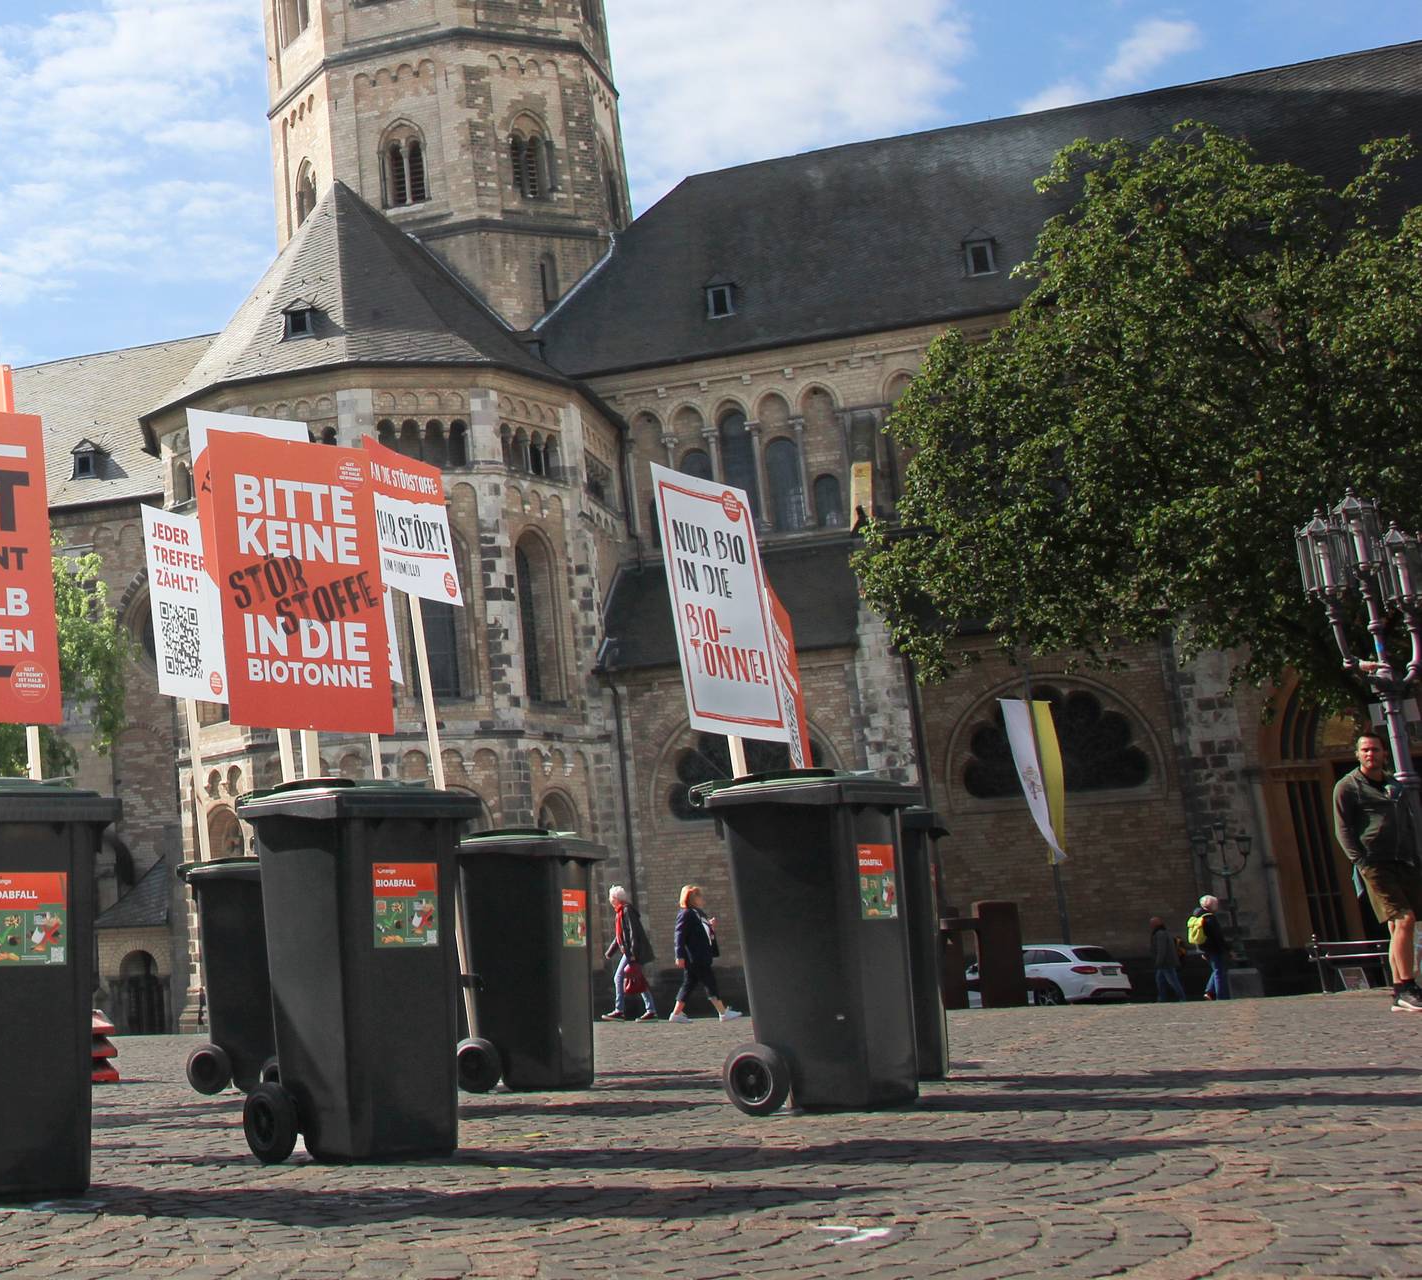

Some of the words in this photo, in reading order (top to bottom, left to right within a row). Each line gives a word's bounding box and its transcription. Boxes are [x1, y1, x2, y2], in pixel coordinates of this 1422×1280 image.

[234, 473, 356, 525] BITTE
[151, 521, 189, 547] JEDER
[237, 516, 360, 565] KEINE
[398, 513, 448, 553] STÖRT!
[671, 518, 709, 560] NUR
[714, 530, 746, 565] BIO
[153, 545, 206, 573] TREFFER
[156, 566, 199, 594] ZÄHLT!
[228, 552, 308, 609] STÖR
[677, 557, 699, 593] IN
[702, 564, 732, 600] DIE
[275, 571, 379, 636] STOFFE
[685, 602, 732, 643] BIO-
[243, 613, 289, 657] IN
[300, 617, 371, 662] DIE
[247, 657, 373, 689] BIOTONNE
[689, 638, 769, 685] TONNE!
[375, 879, 416, 888] BIOABFALL
